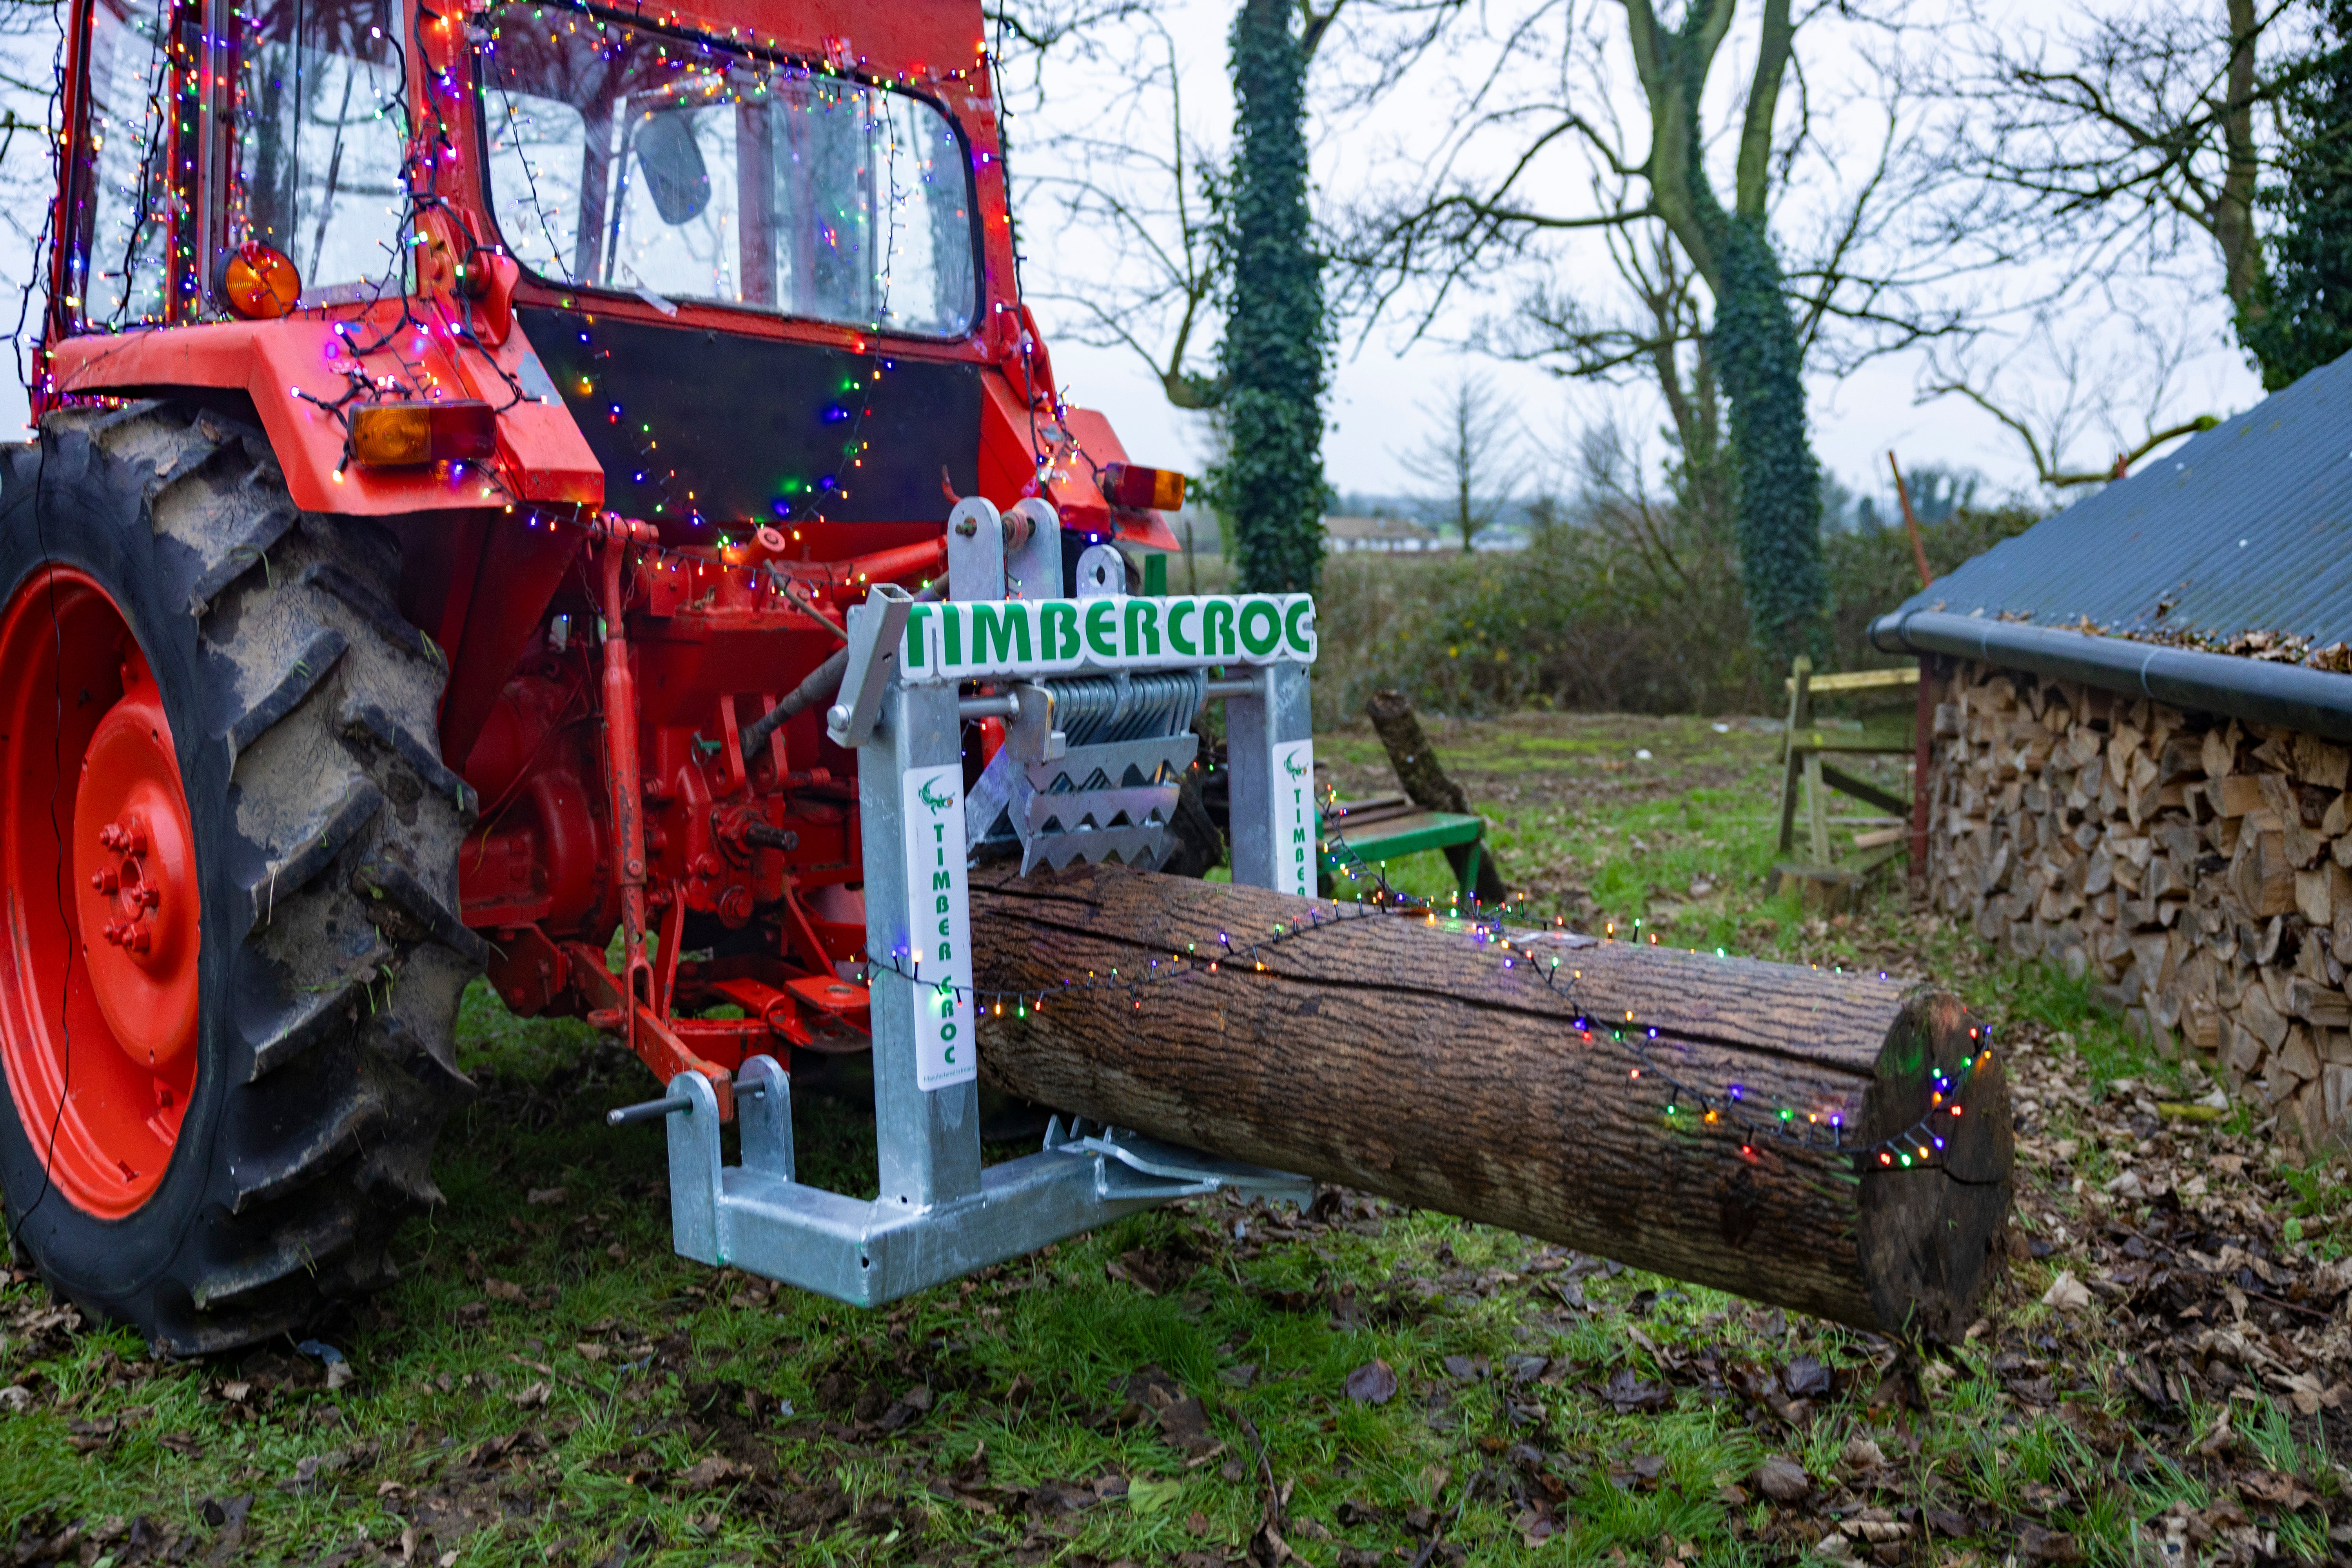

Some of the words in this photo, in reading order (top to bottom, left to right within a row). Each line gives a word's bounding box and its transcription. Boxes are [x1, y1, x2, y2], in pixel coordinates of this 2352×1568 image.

[906, 600, 1310, 668] TIMBERCROC
[933, 822, 951, 961] TIMBER
[940, 975, 957, 1064] CROC
